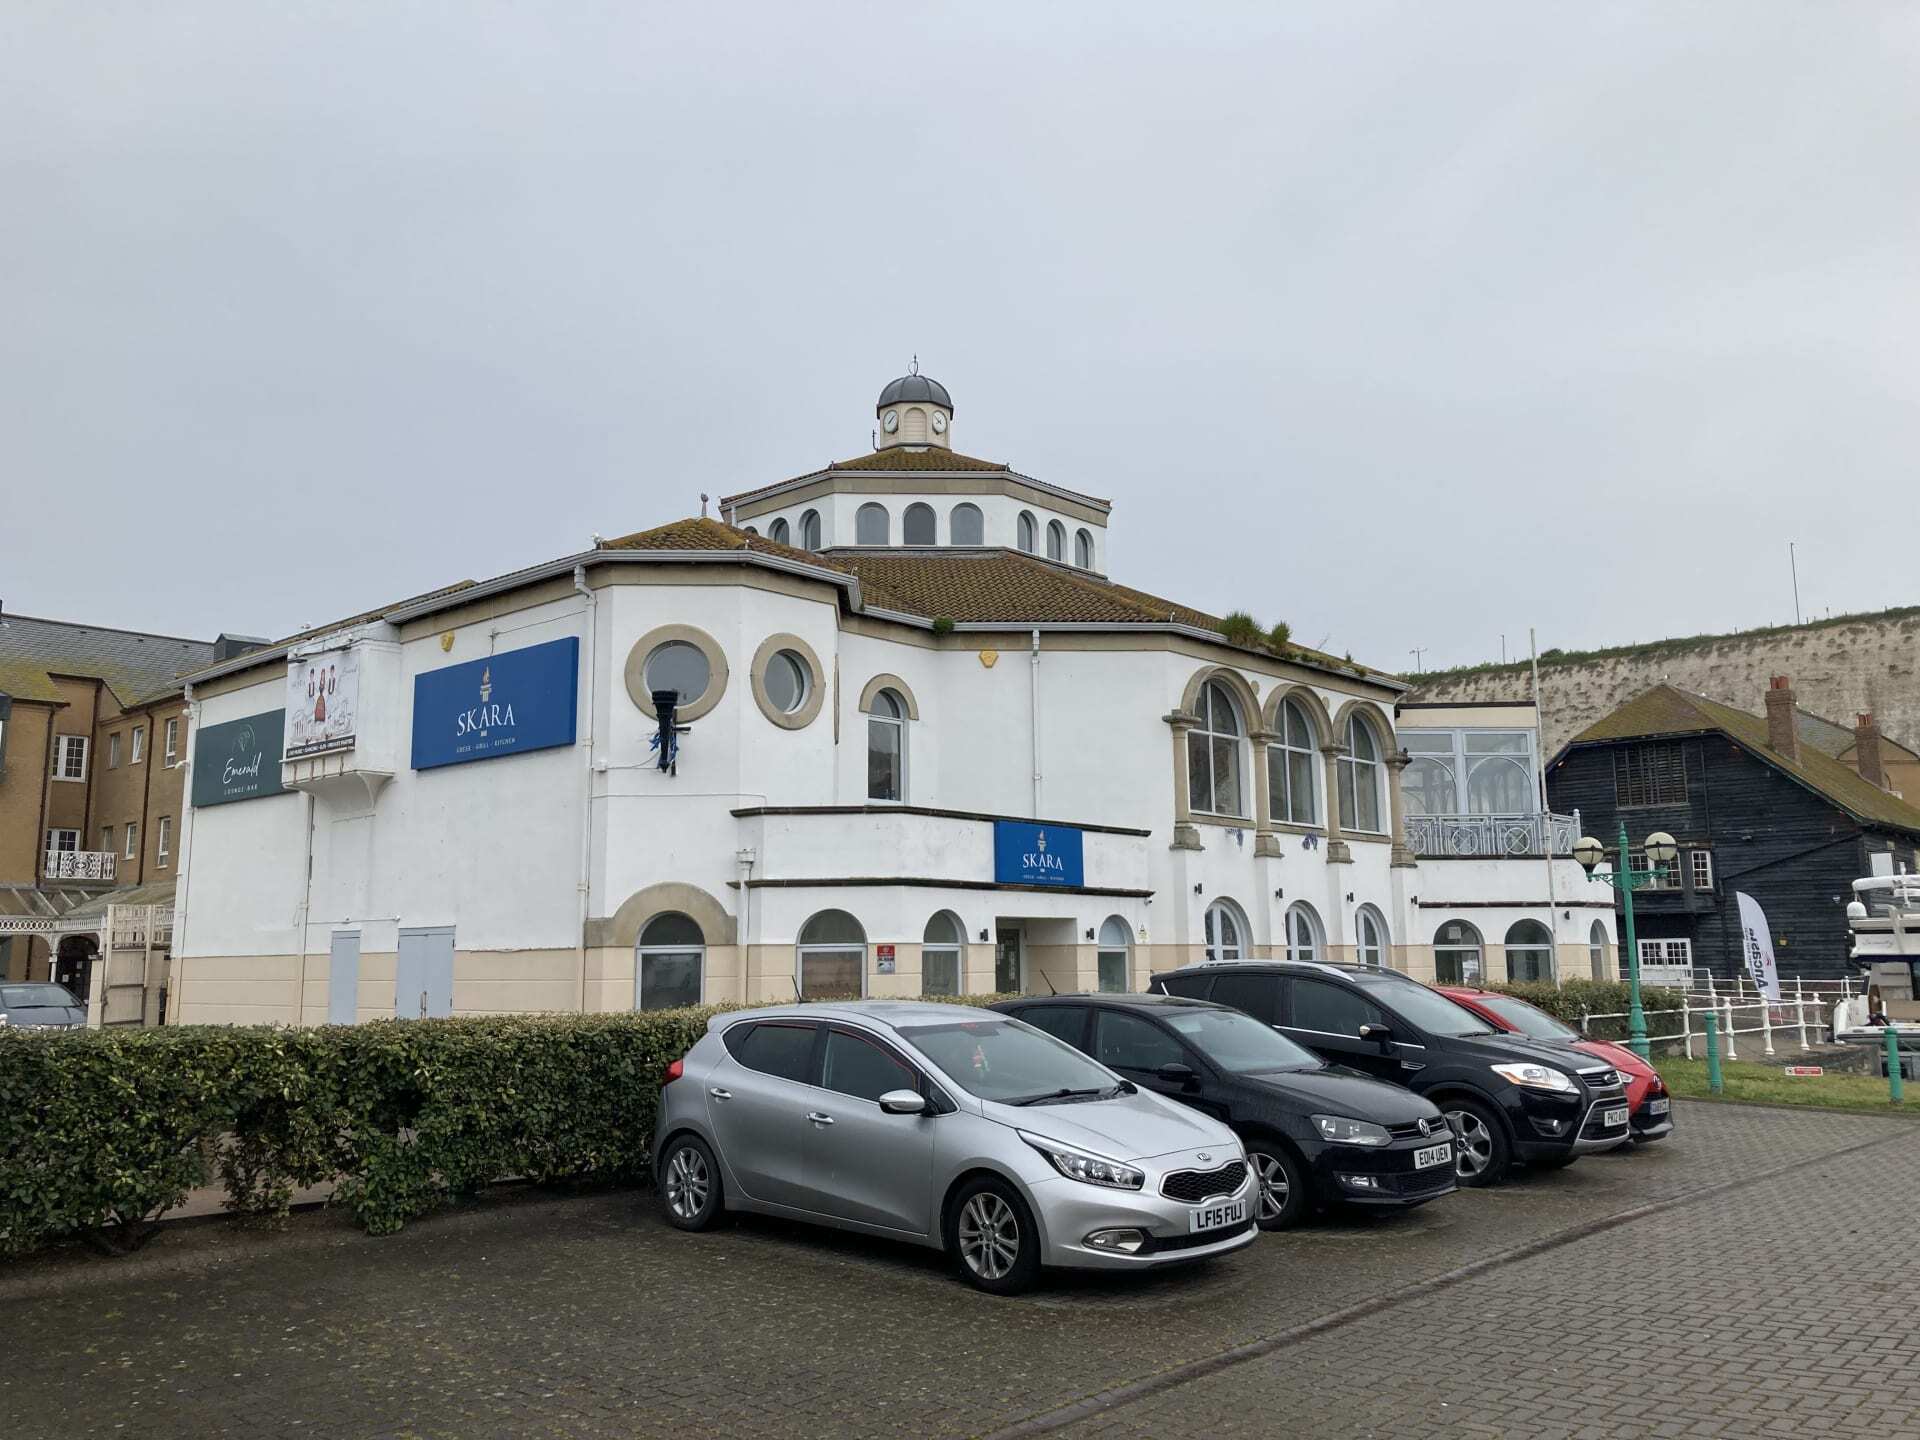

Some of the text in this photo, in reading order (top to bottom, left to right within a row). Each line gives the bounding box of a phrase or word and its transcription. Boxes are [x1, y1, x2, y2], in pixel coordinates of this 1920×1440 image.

[457, 703, 516, 737] SKARA
[223, 751, 262, 784] Emerald
[1023, 853, 1063, 871] SKARA
[1196, 1202, 1242, 1229] LF15 FUJ
